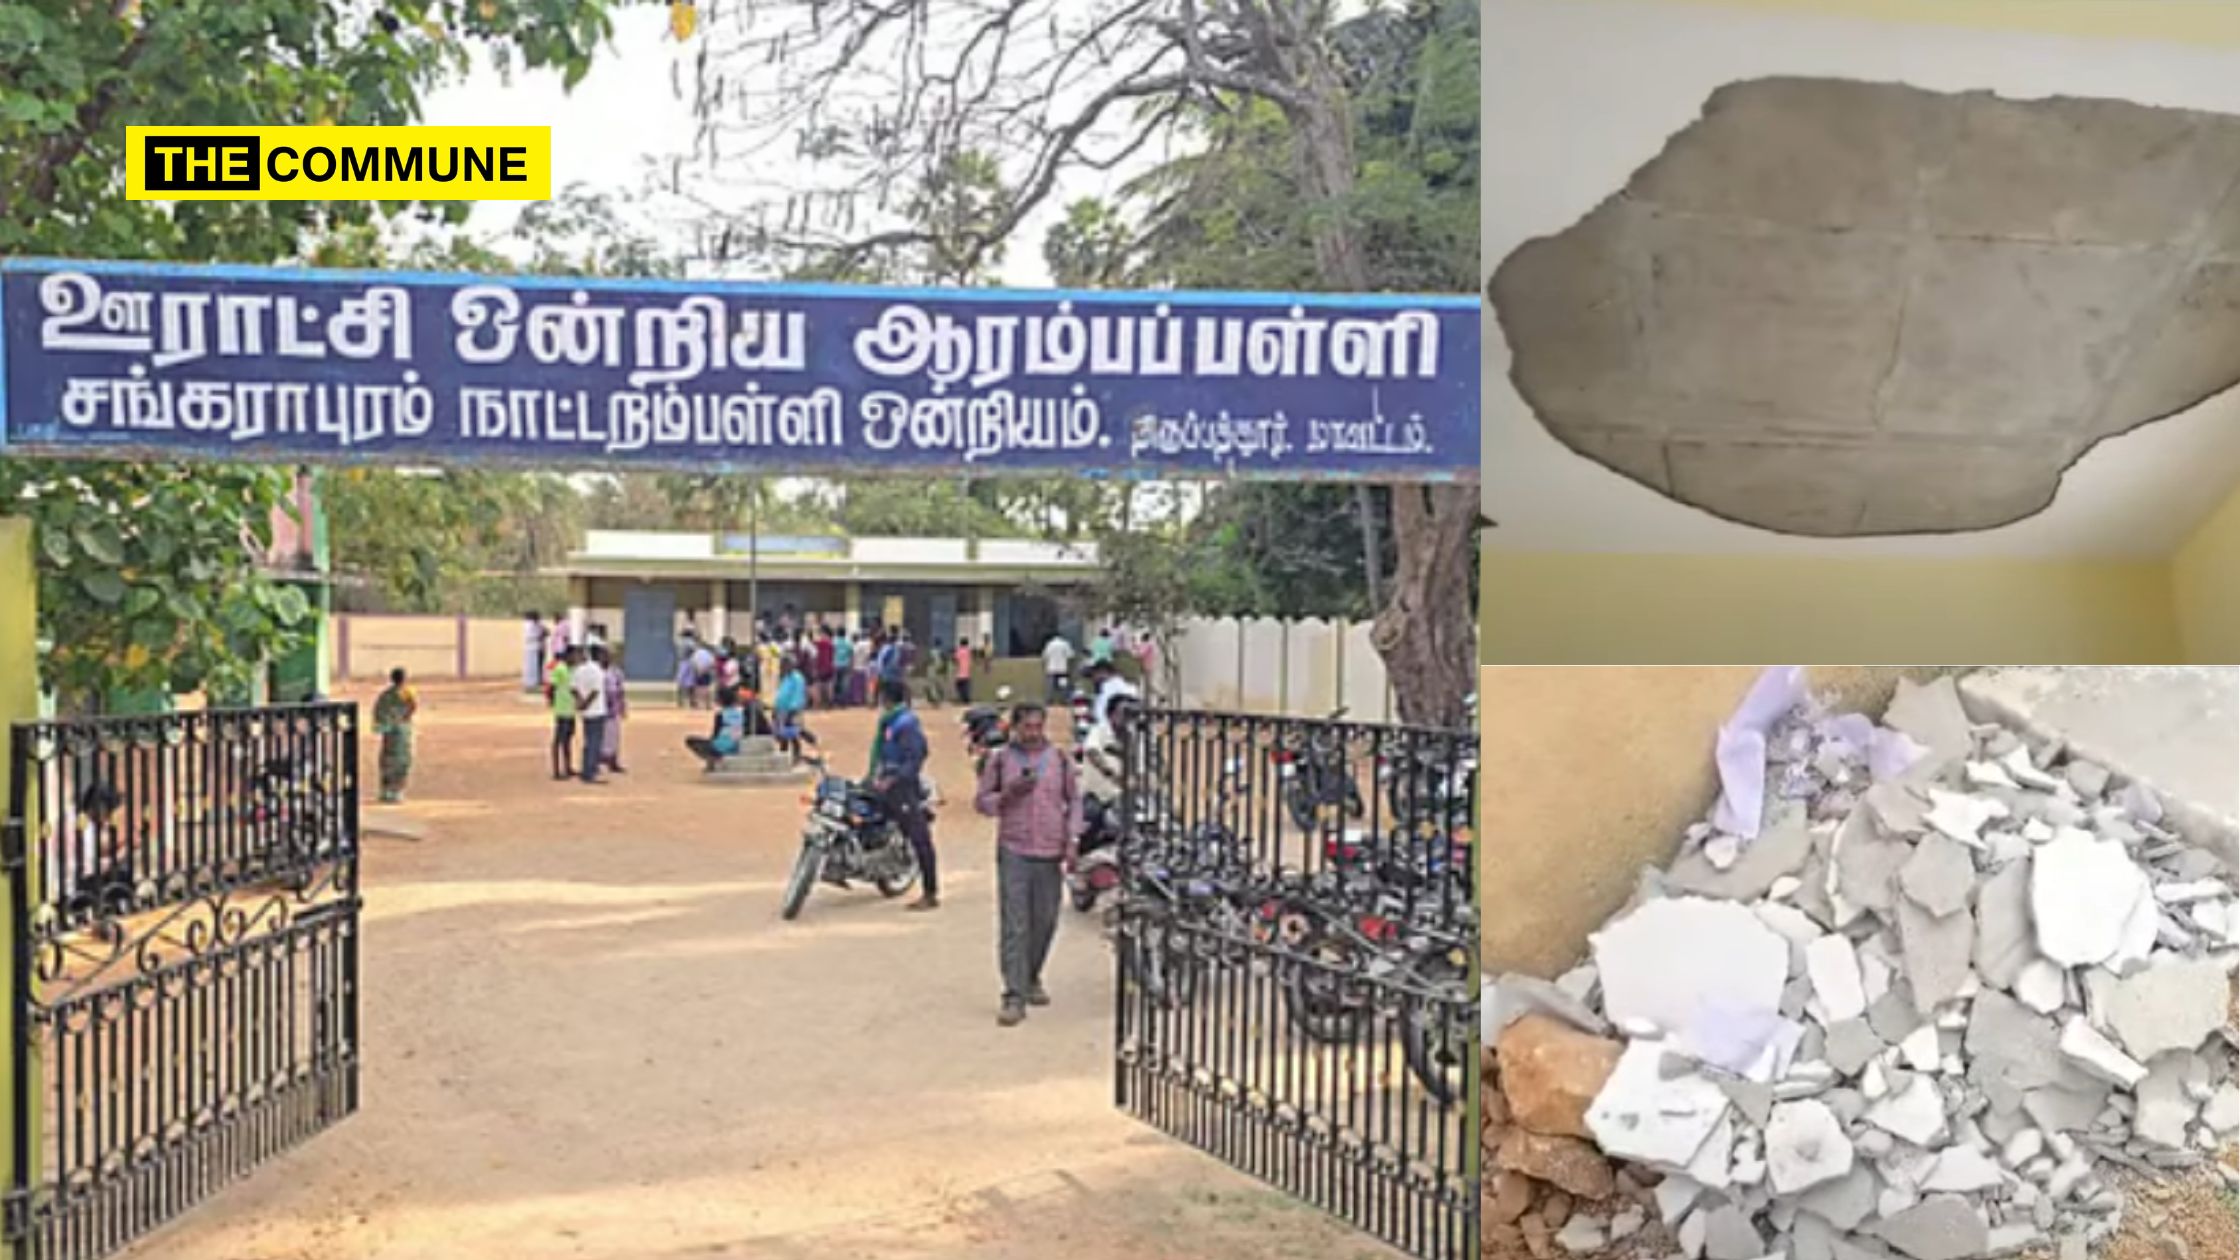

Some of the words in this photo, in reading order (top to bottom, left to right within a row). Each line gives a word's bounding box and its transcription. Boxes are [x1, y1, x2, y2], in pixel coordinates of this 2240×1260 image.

[39, 272, 412, 366] ஊராட்சி
[451, 284, 806, 388] ஒன்றிய
[61, 364, 433, 446] சங்கராபுரம்
[860, 383, 1112, 463] ஒன்றியம்.
